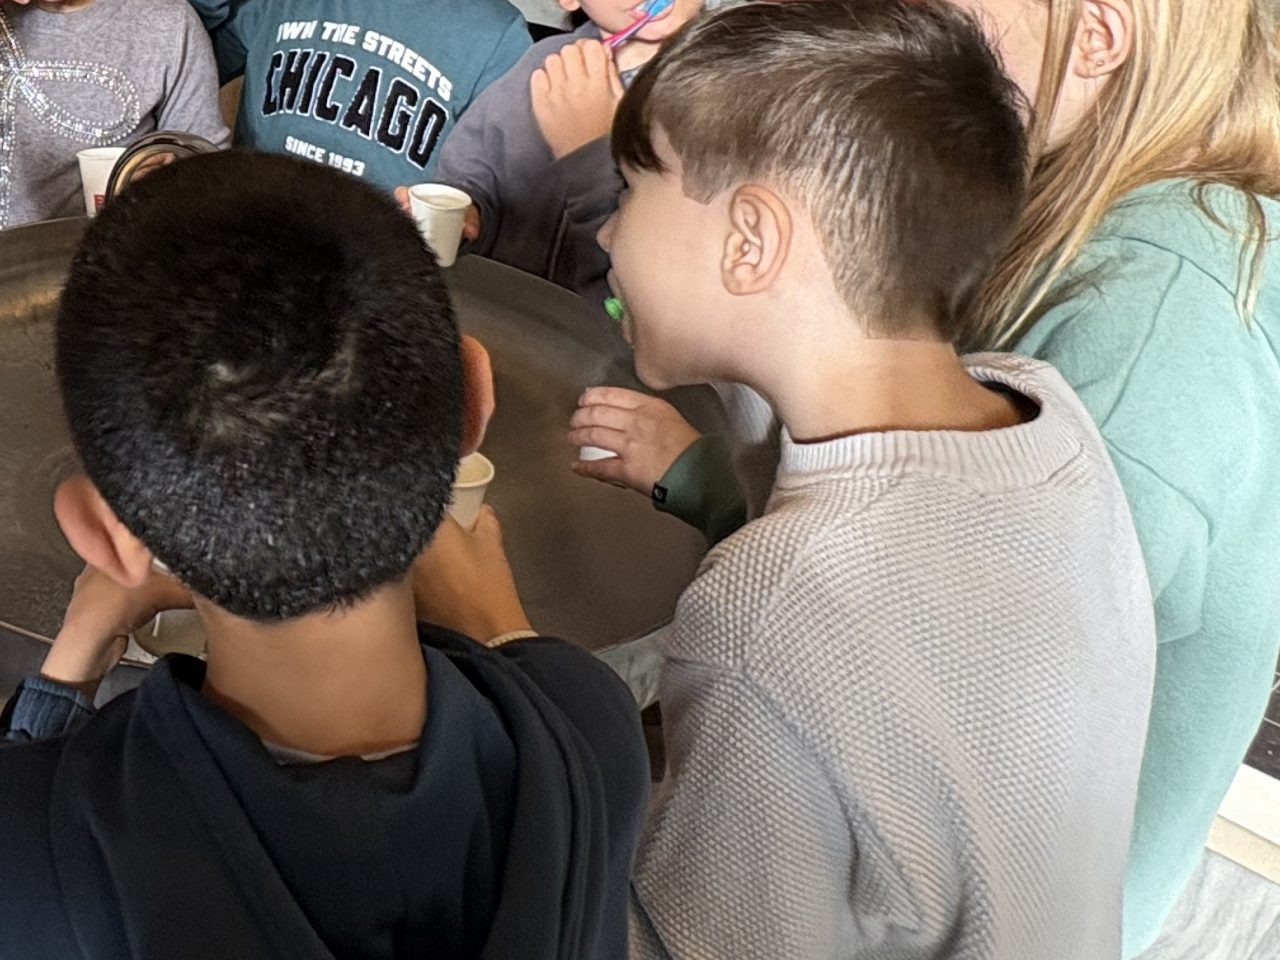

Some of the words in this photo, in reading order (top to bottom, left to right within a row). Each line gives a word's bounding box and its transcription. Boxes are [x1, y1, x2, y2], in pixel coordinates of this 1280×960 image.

[276, 20, 319, 44] WN
[362, 30, 453, 101] STREETS
[261, 48, 449, 170] CHICAGO
[284, 135, 326, 164] SINCE
[328, 152, 365, 177] 1993
